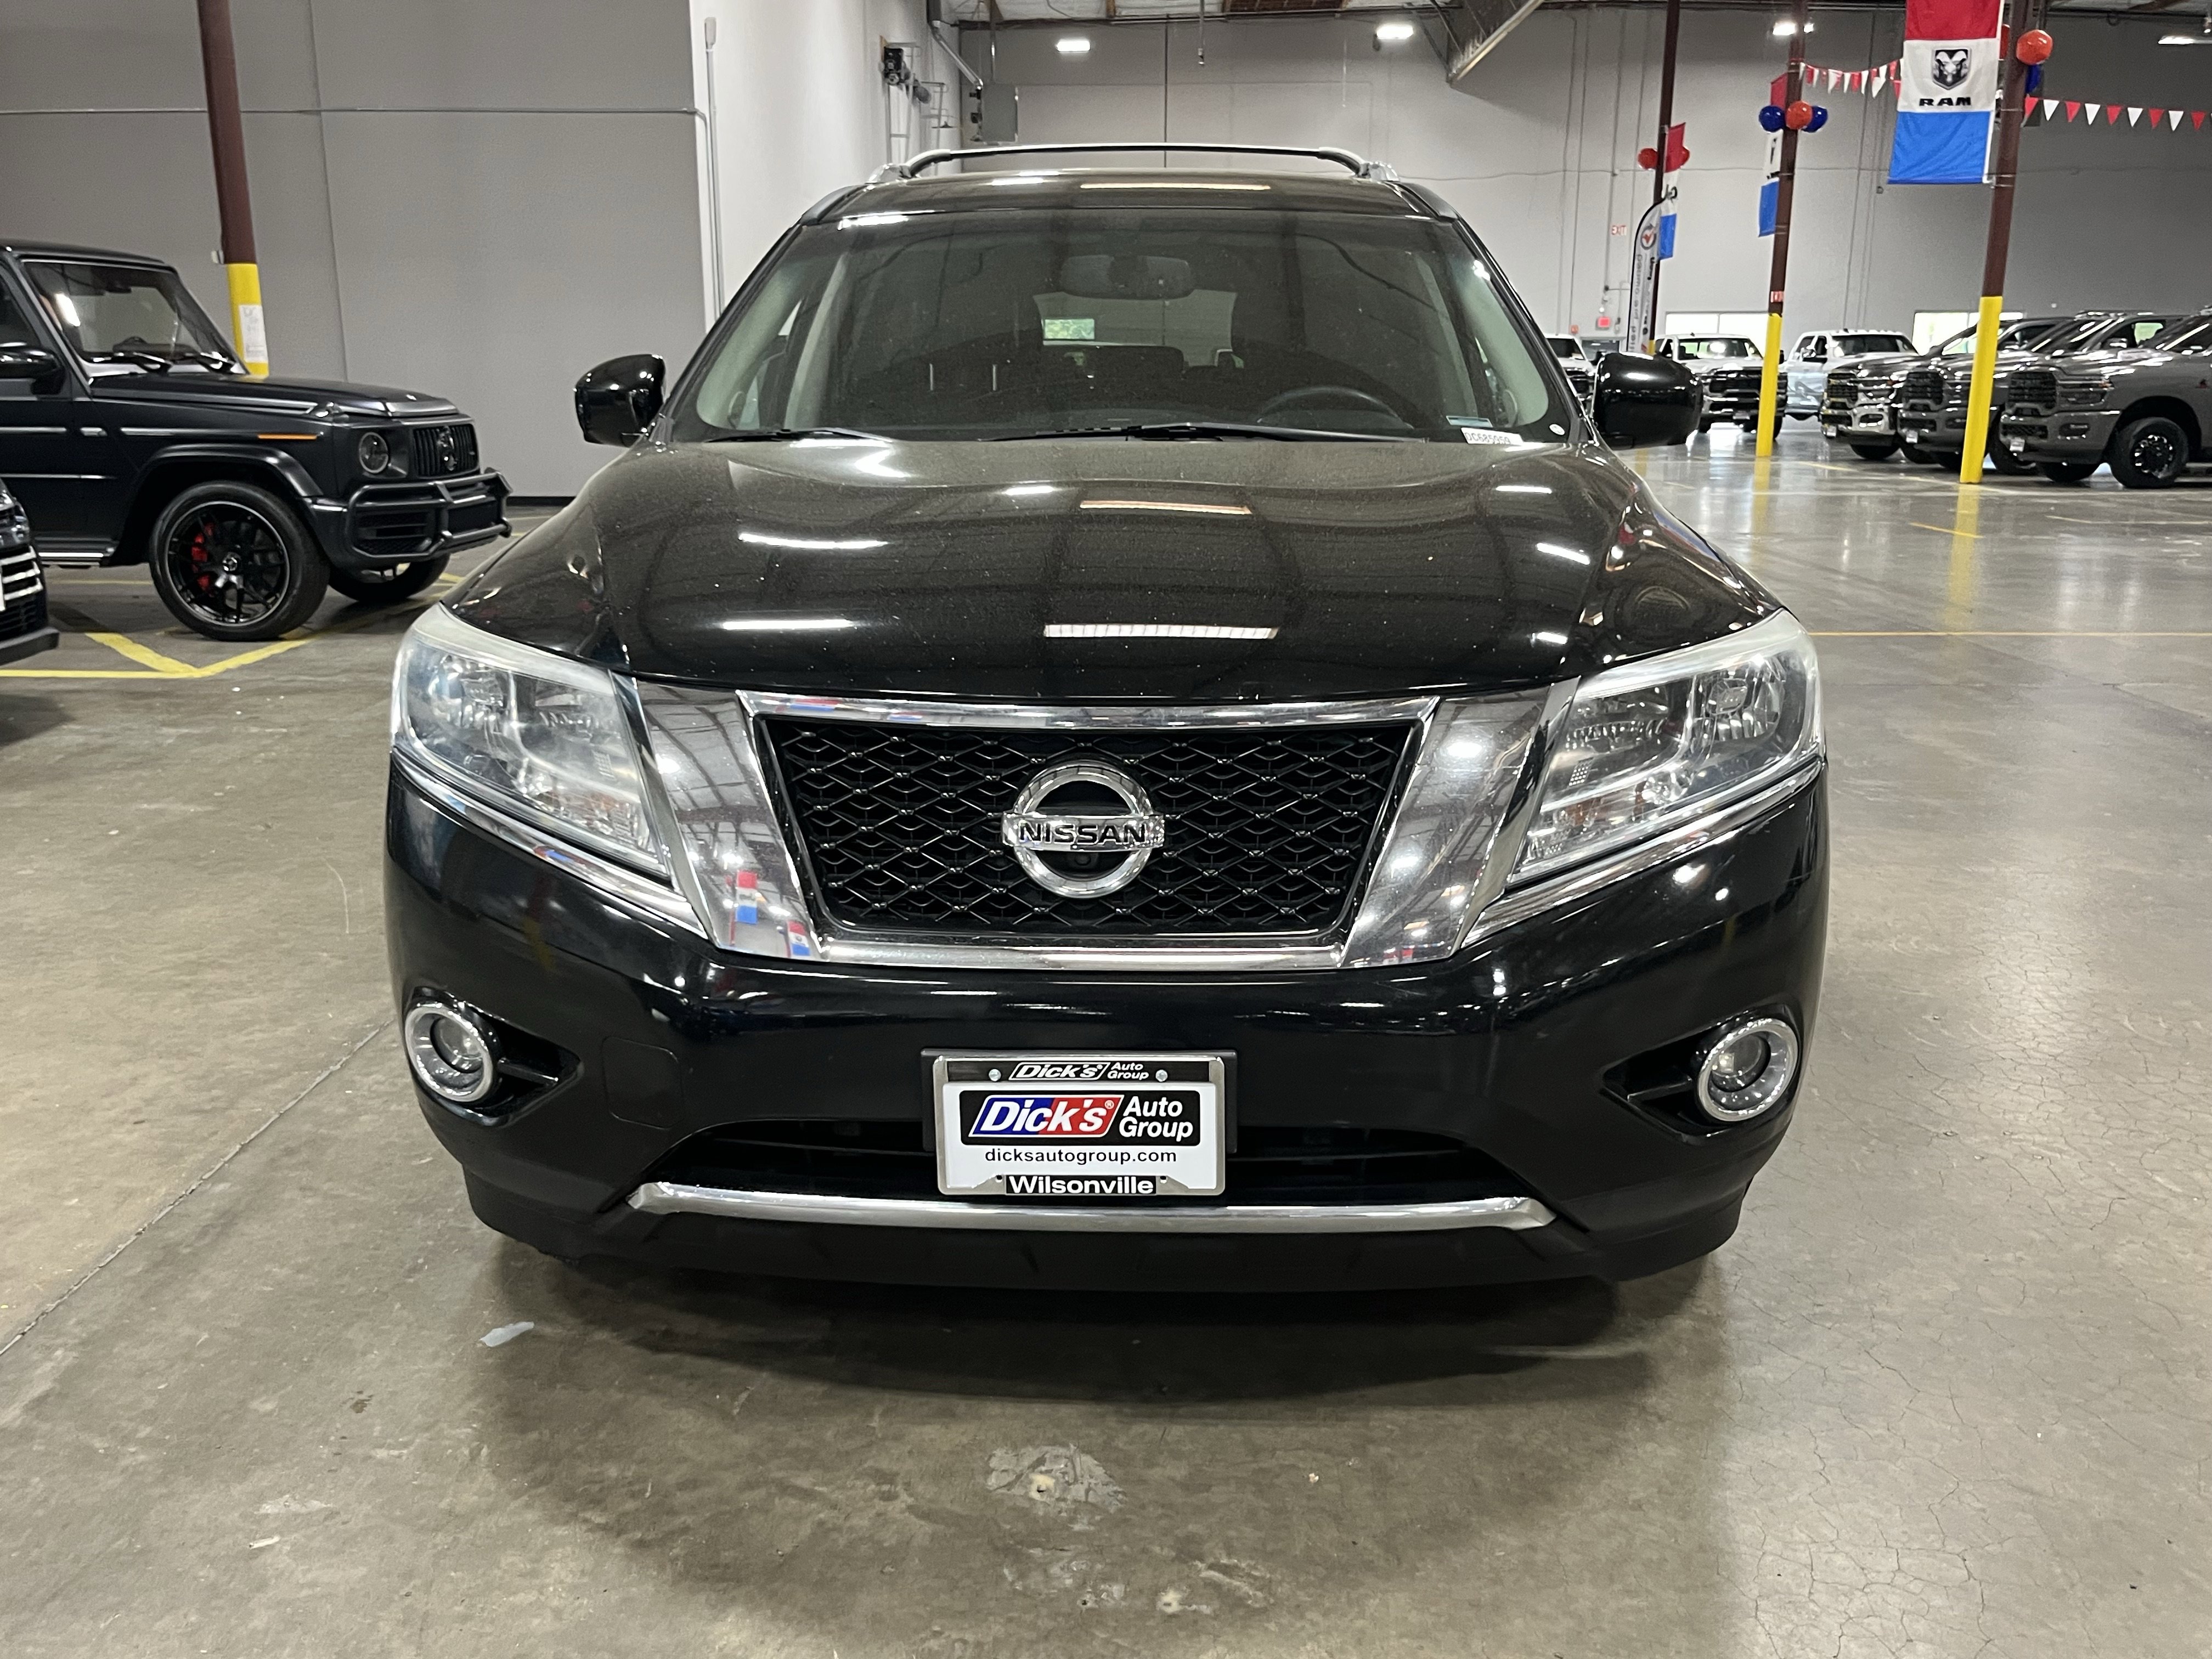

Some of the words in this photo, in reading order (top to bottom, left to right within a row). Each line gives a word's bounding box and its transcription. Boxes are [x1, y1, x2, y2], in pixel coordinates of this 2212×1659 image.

[1919, 97, 1971, 106] RAM
[1018, 820, 1147, 845] NISSAN
[1015, 1064, 1097, 1079] Dick's
[1111, 1062, 1143, 1070] Auto
[1108, 1070, 1149, 1080] Group
[980, 1098, 1107, 1132] Dick's
[1123, 1096, 1183, 1117] Auto
[1119, 1116, 1193, 1142] Group
[985, 1148, 1176, 1165] dicksautogroup.com
[1008, 1175, 1154, 1194] Wilsonville
